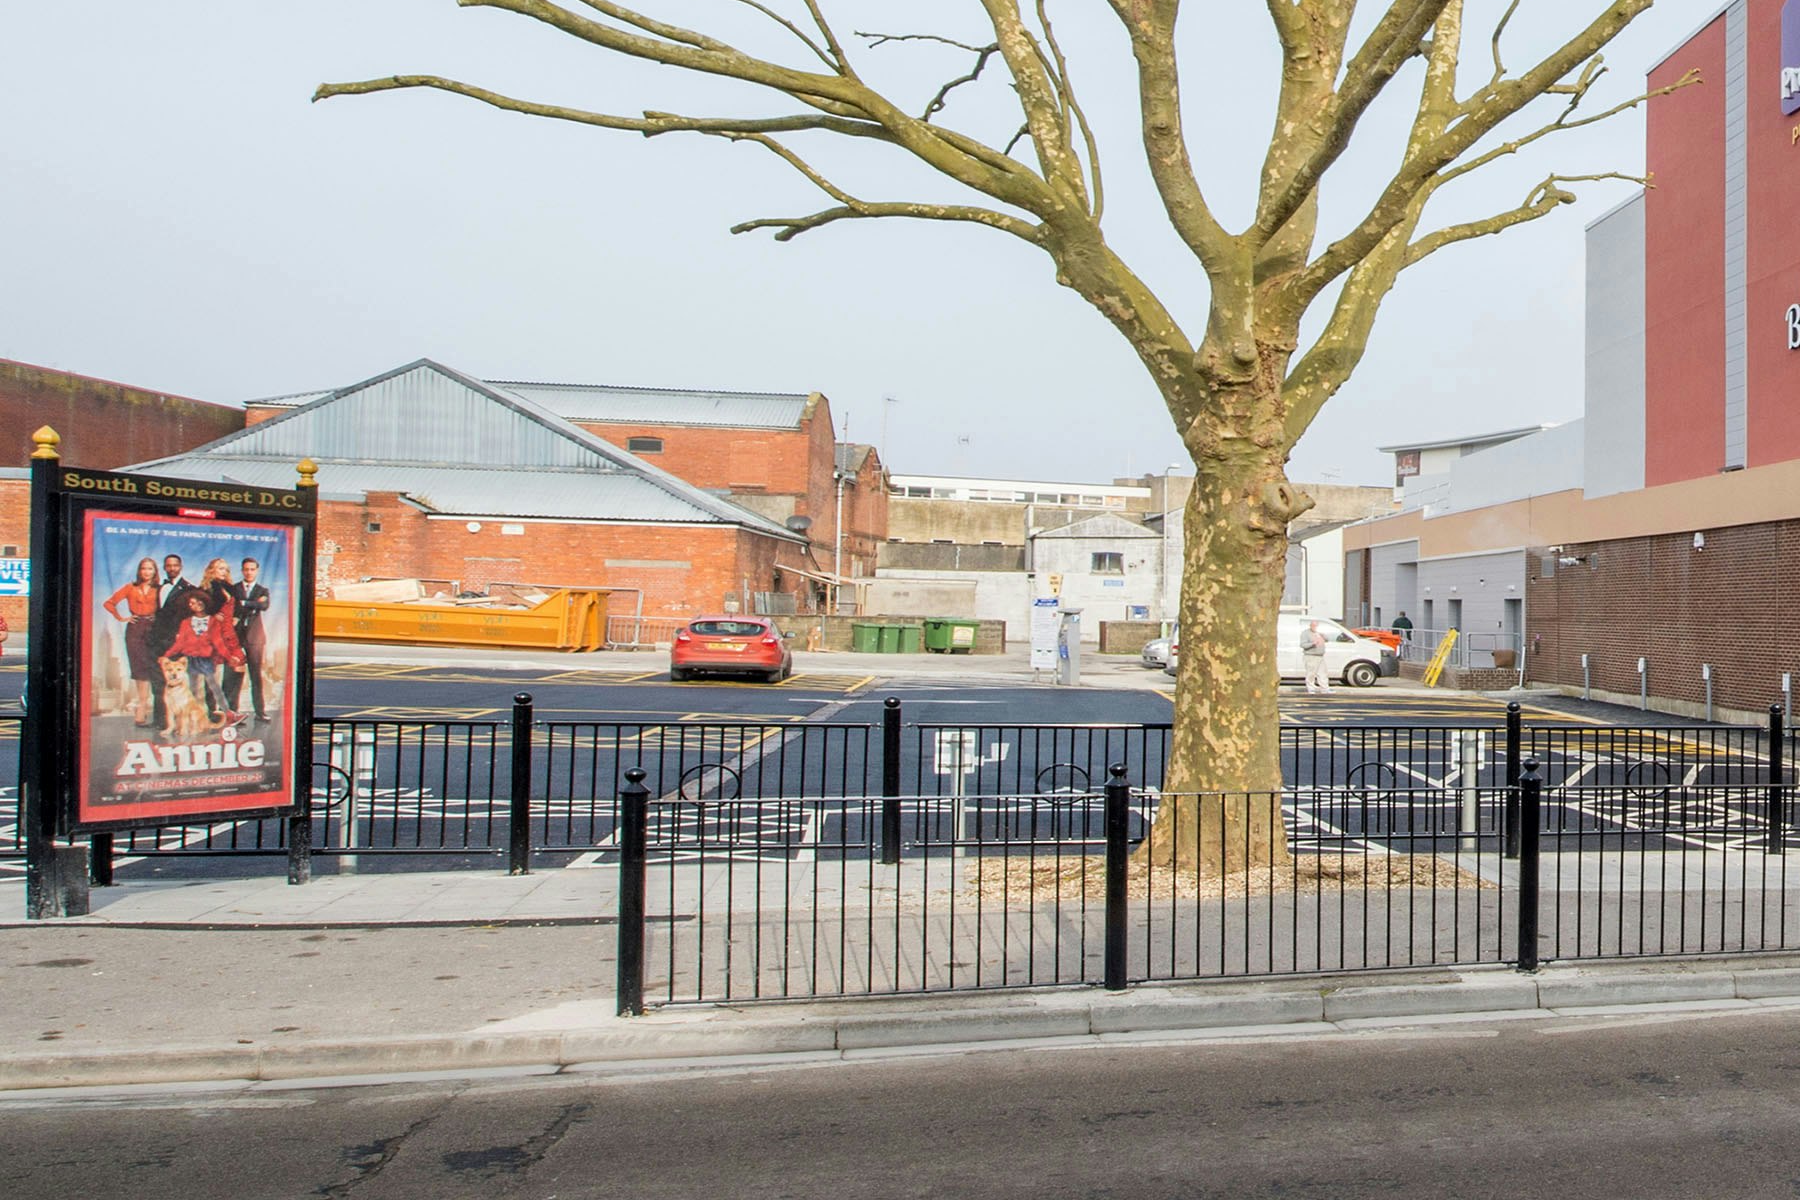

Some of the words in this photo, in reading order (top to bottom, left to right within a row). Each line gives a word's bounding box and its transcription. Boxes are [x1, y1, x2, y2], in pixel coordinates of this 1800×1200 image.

[64, 473, 138, 493] South
[146, 482, 253, 505] Somerset
[259, 492, 303, 509] D.C.
[117, 727, 265, 776] Annie
[115, 781, 131, 793] AT
[135, 778, 188, 790] CINEMAS
[191, 773, 249, 786] DECEMBER
